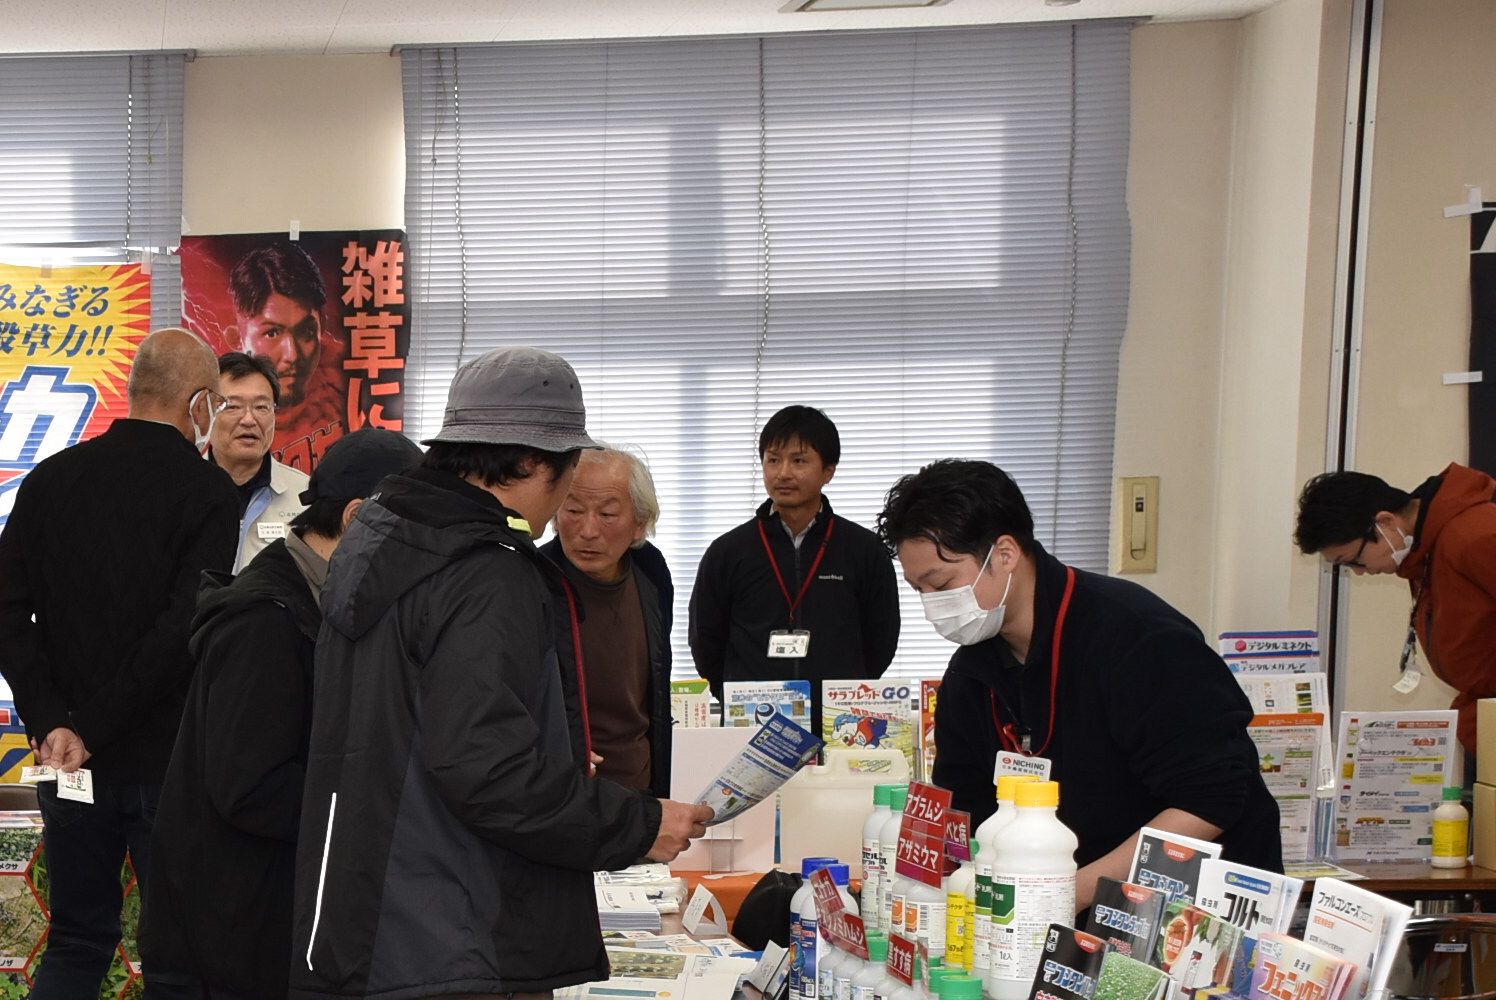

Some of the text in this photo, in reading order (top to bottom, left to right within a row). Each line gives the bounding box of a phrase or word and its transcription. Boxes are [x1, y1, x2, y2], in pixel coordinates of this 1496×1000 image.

[1012, 759, 1045, 771] NICHINO
[904, 792, 943, 822] アブラムシ
[898, 837, 939, 870] アザミウマ
[1219, 891, 1260, 931] コルト
